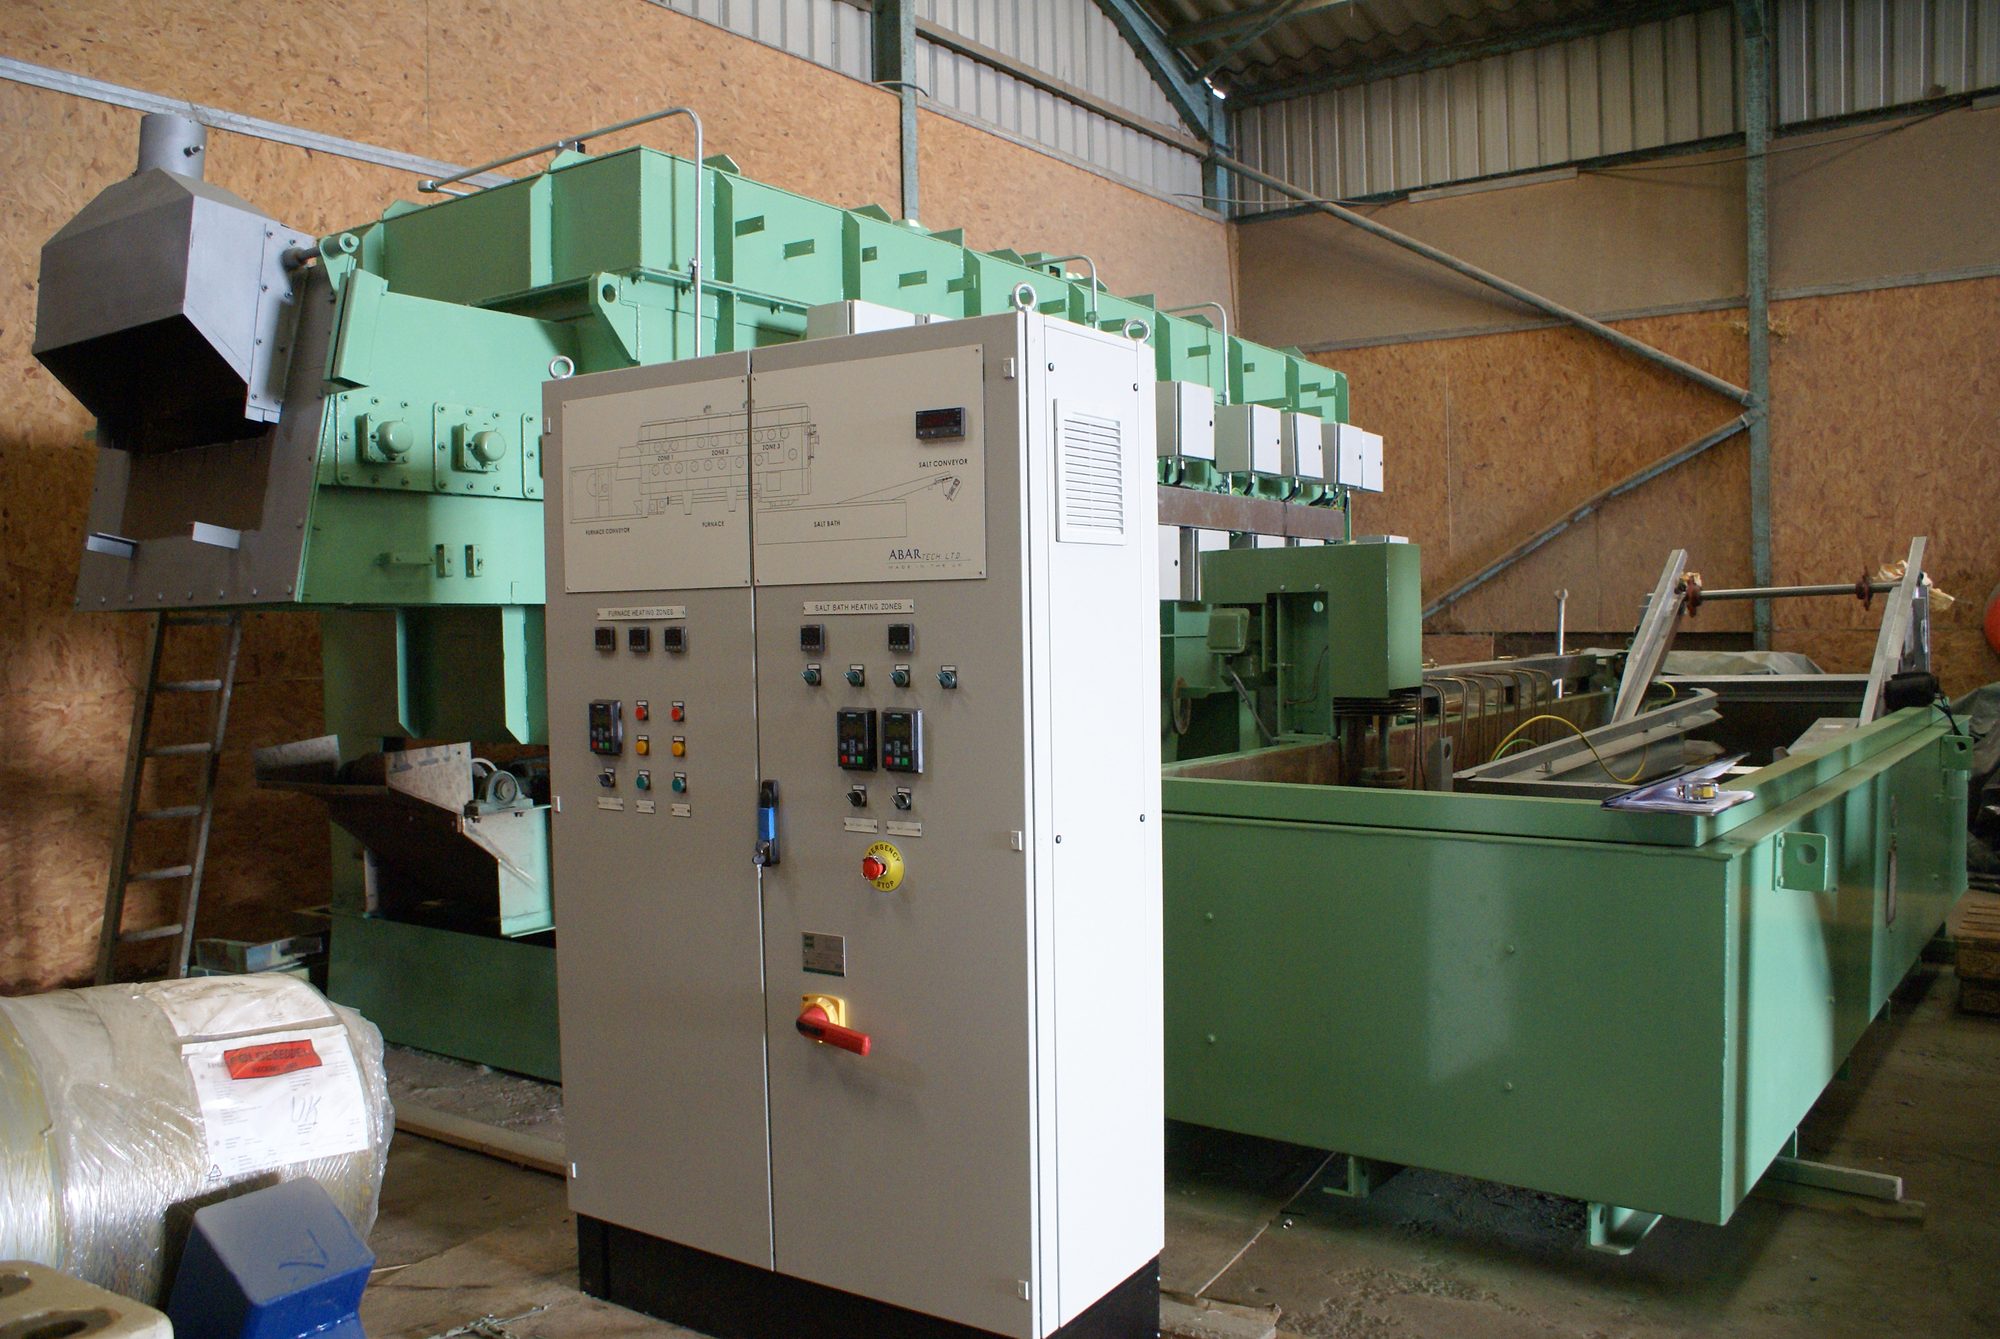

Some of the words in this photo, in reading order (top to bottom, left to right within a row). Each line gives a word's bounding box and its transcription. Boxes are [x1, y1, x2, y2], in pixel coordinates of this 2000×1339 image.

[933, 458, 968, 467] CONVEYOR
[605, 527, 630, 535] CONVEYOR
[832, 603, 849, 611] BATH
[850, 603, 879, 611] HEATING
[881, 602, 902, 610] ZONES
[608, 609, 631, 617] FURNACE
[656, 608, 674, 616] ZONES
[868, 844, 901, 862] ERGENCY
[877, 880, 894, 889] STOP
